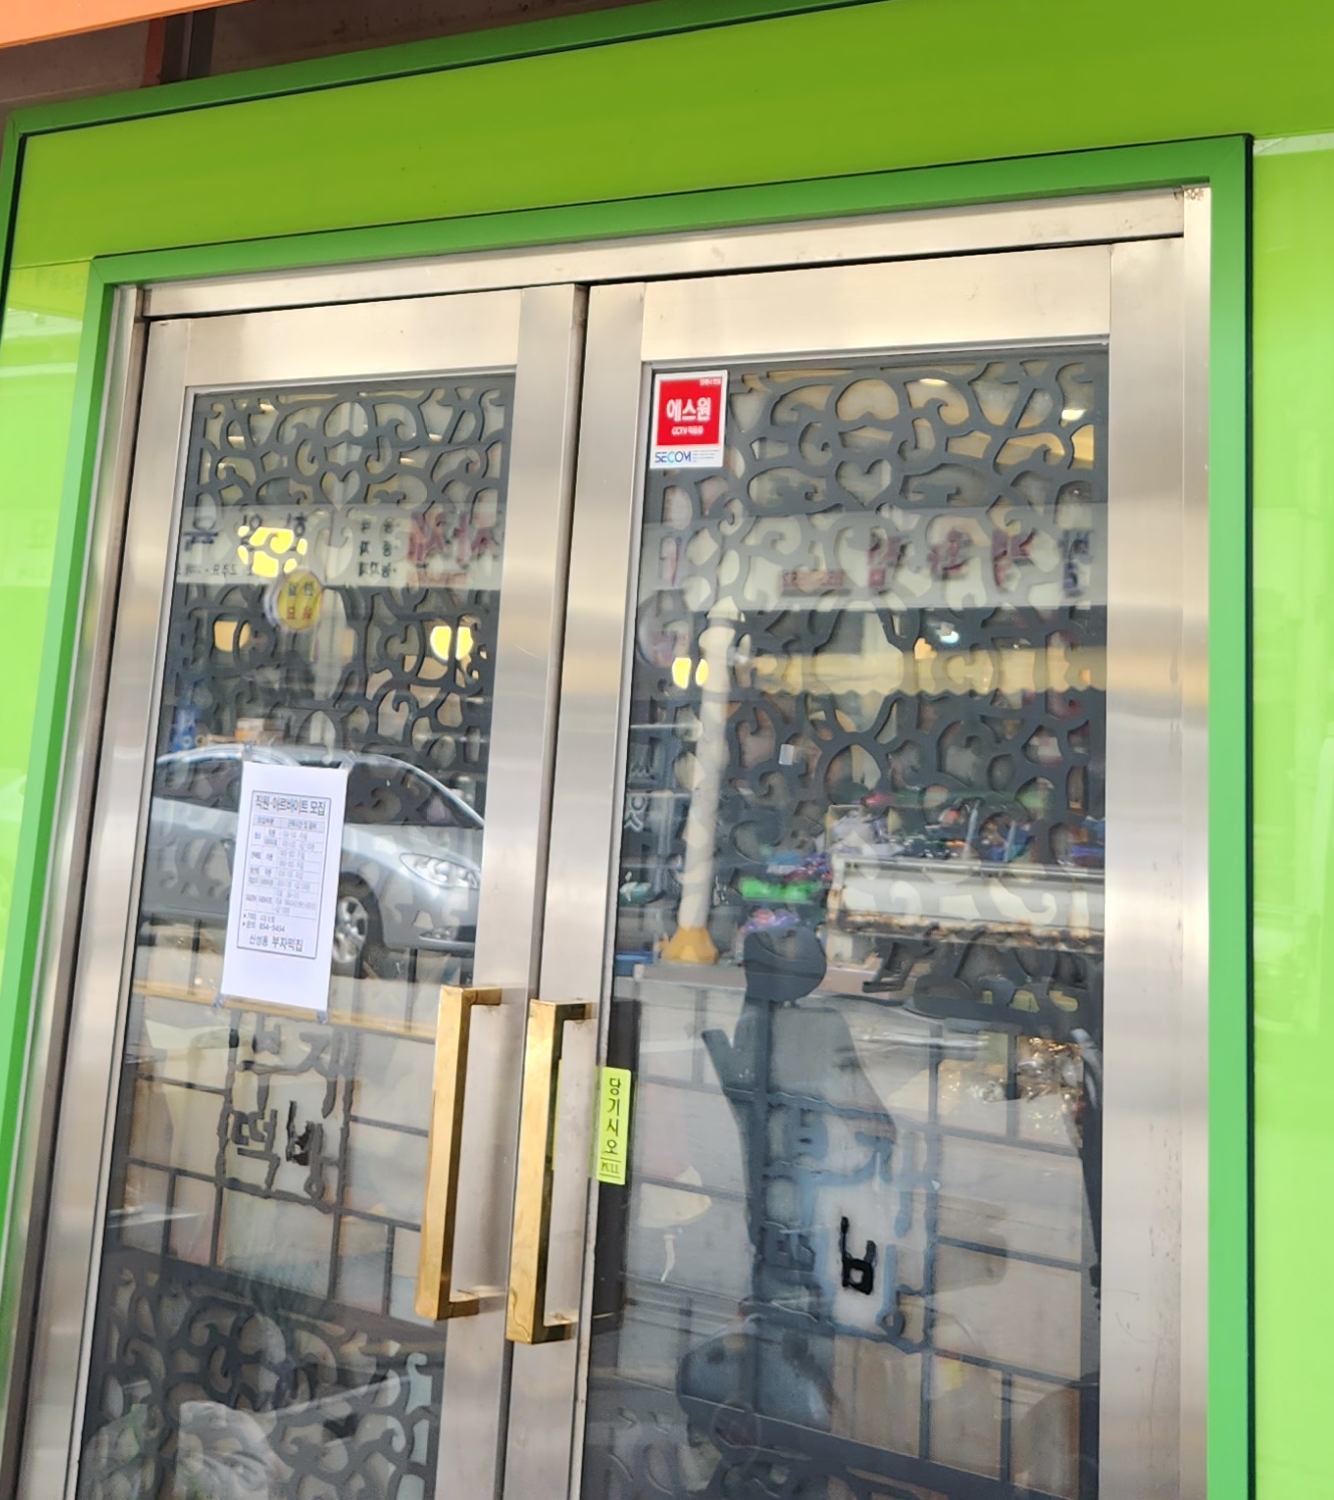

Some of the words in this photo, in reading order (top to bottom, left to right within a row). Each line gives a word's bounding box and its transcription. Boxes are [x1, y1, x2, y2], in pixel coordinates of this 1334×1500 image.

[665, 396, 712, 423] 에스원
[654, 450, 692, 464] SECOM
[309, 800, 327, 817] 모집
[271, 935, 304, 952] 부자떡집
[605, 1077, 622, 1156] 당기시오
